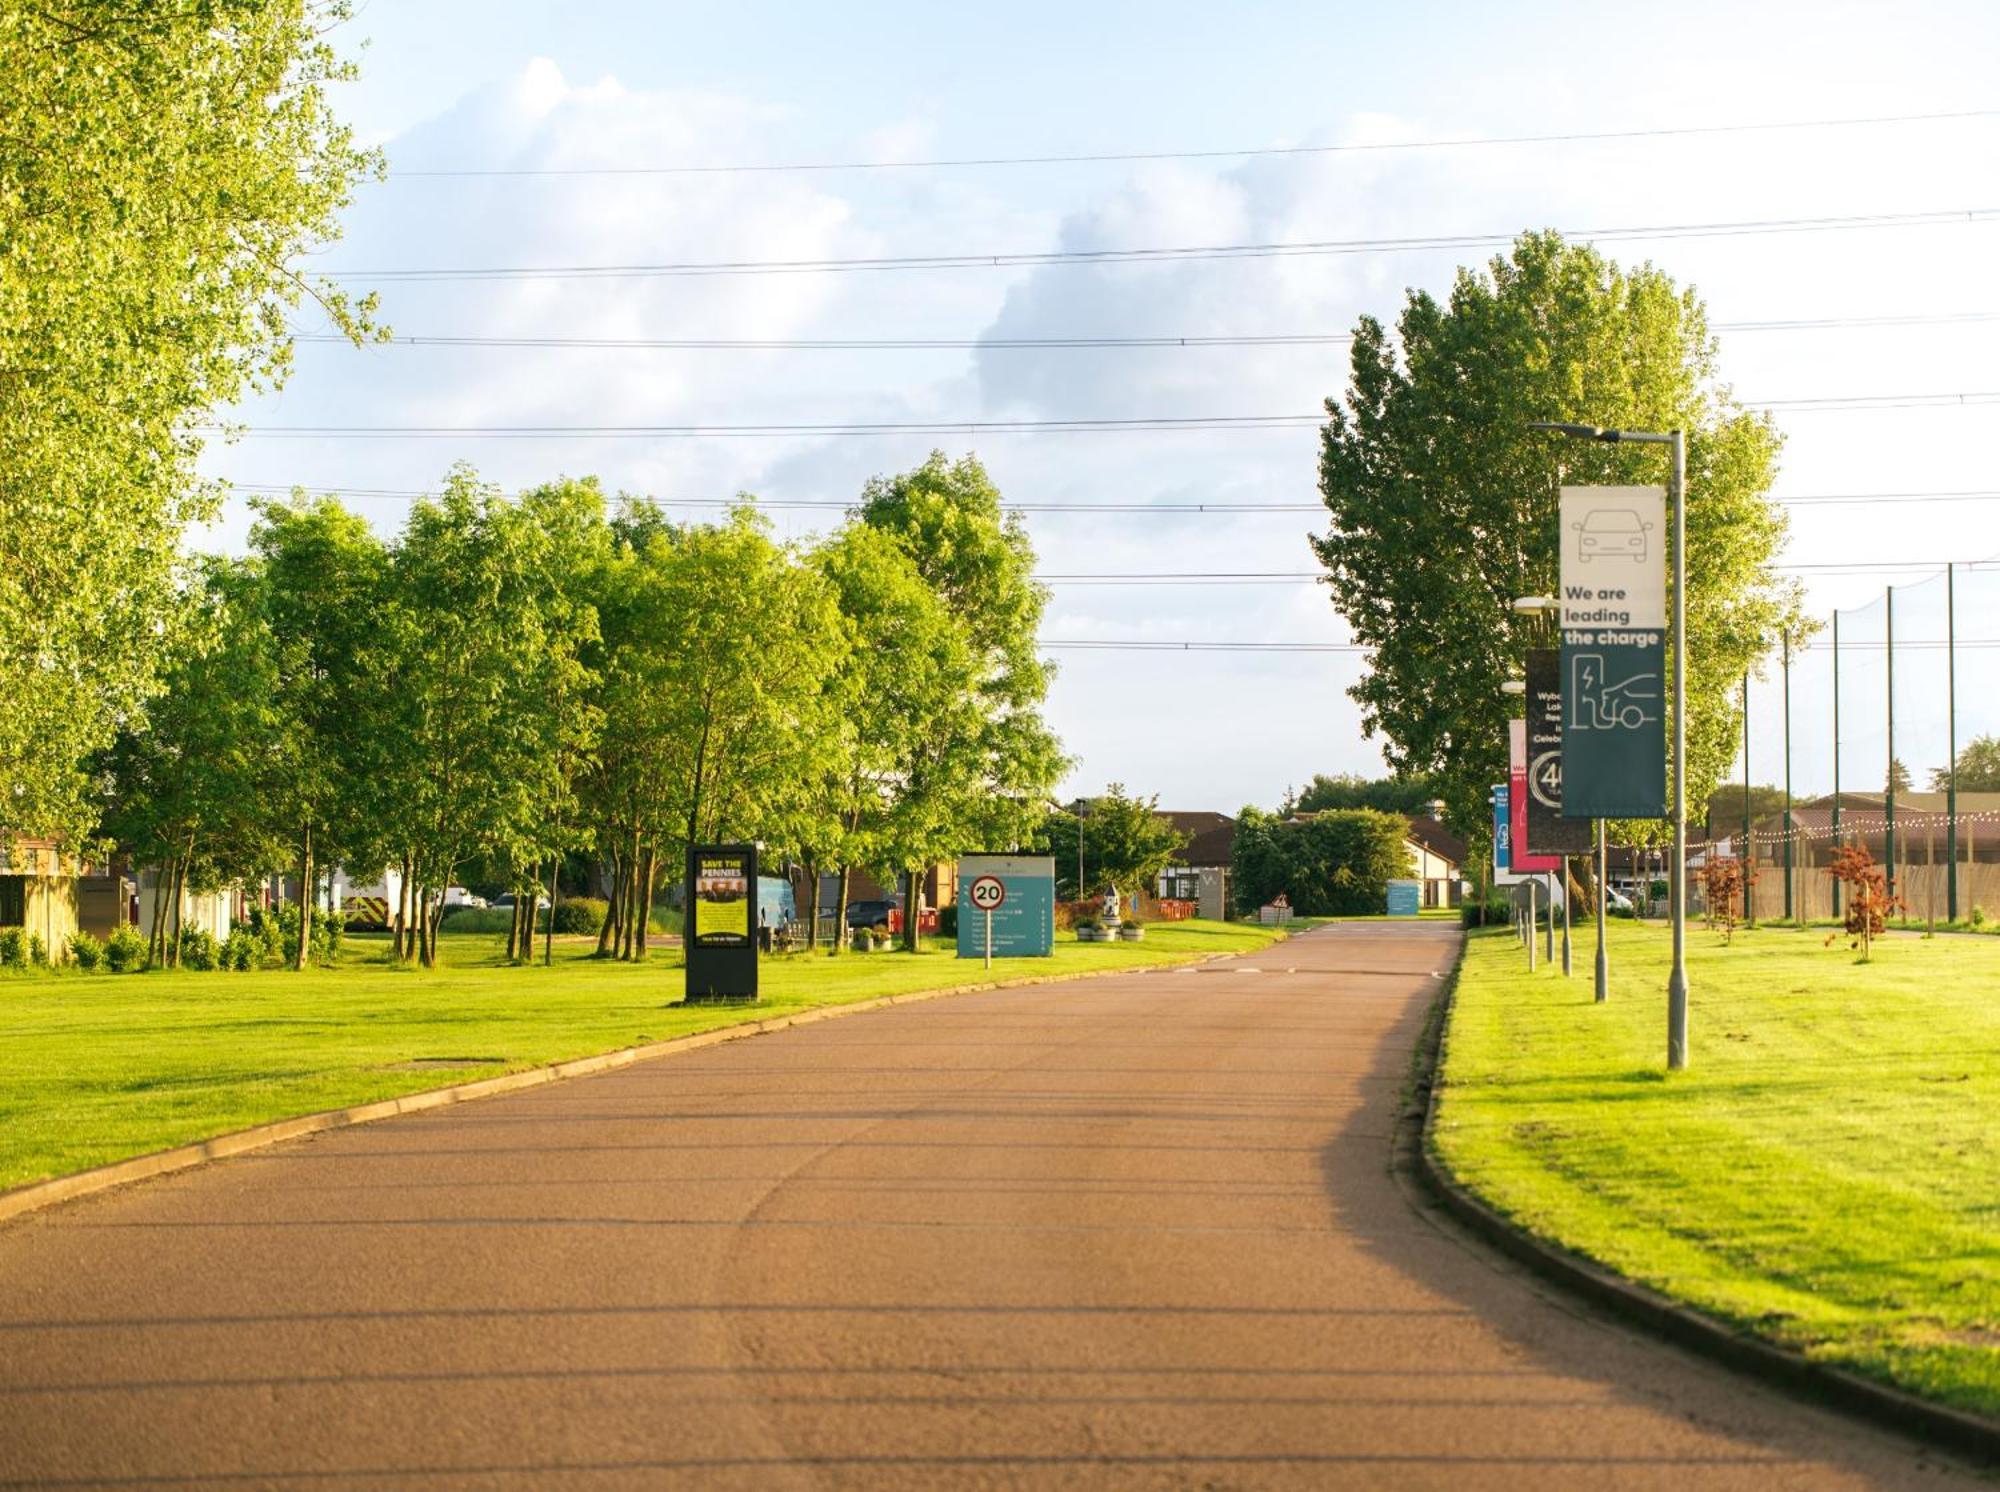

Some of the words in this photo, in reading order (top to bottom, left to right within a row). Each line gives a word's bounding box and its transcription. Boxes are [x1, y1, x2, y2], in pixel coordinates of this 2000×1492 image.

[1565, 586, 1593, 600] We
[1597, 588, 1626, 600] are
[1565, 608, 1630, 626] leading
[1564, 630, 1594, 645] the
[1597, 630, 1659, 648] charge
[1540, 763, 1562, 788] 4
[701, 860, 723, 868] SAVE
[725, 860, 742, 868] THE
[701, 868, 742, 877] PENNIES
[976, 886, 1000, 900] 20
